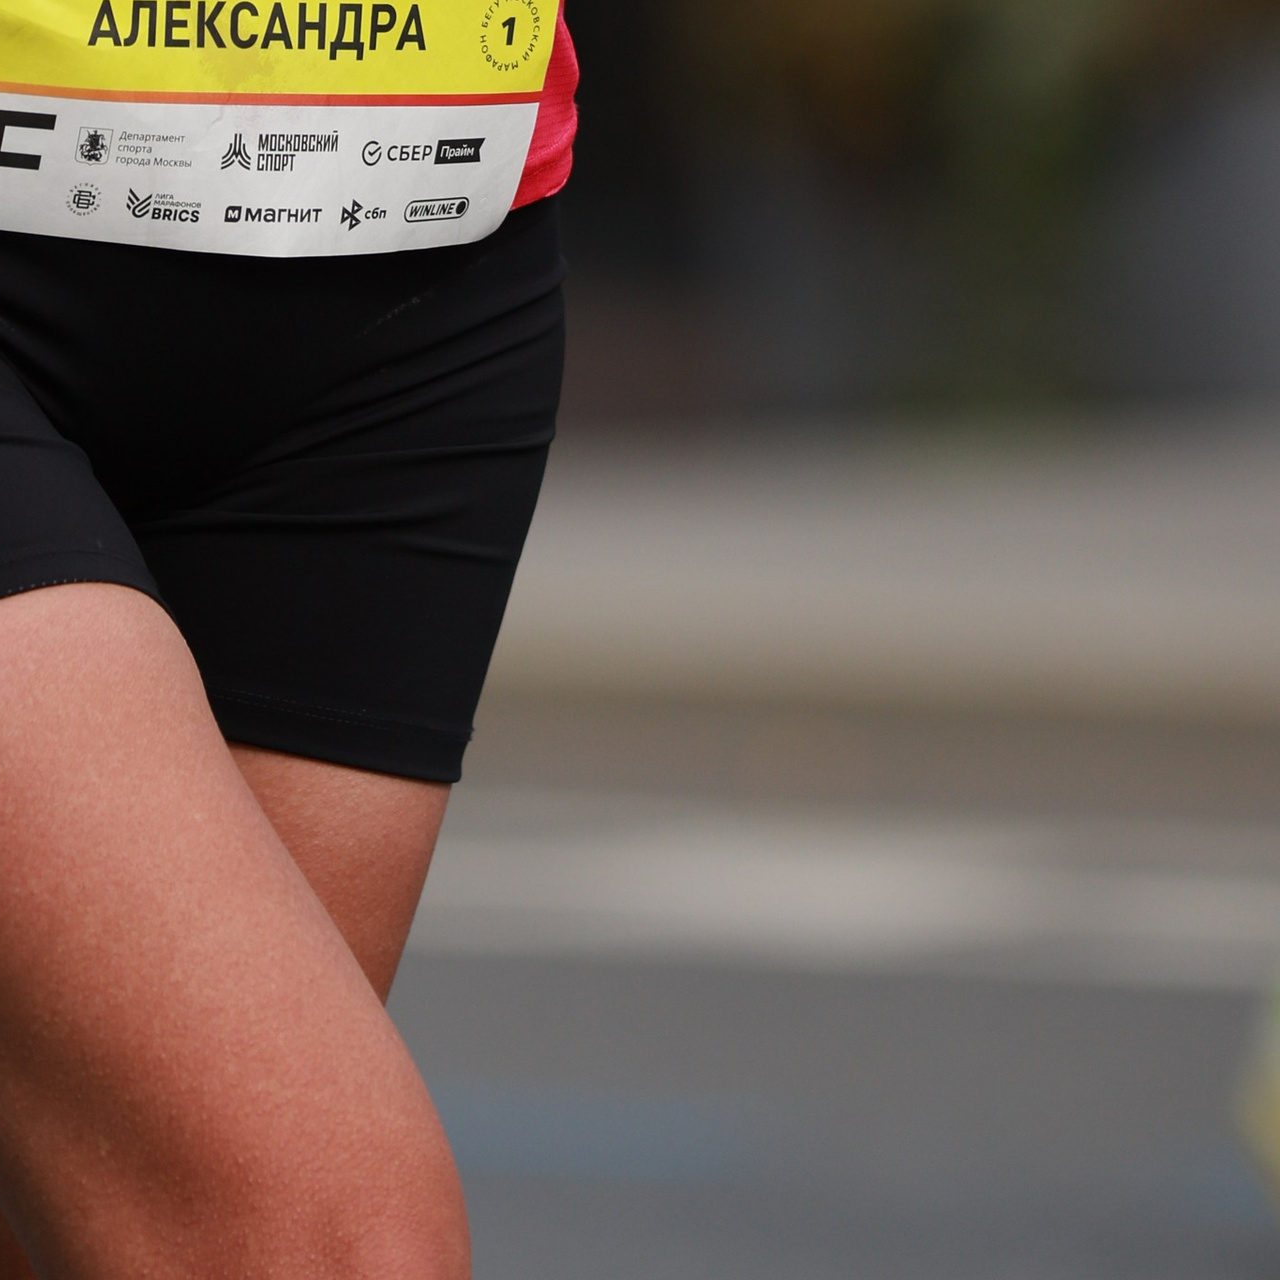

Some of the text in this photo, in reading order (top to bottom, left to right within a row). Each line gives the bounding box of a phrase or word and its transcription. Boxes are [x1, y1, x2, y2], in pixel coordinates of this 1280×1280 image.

[481, 0, 500, 28] БЕГУ
[501, 16, 516, 46] 1
[480, 34, 519, 72] МАРАФОН
[119, 131, 185, 144] Департамент
[257, 130, 339, 153] МОСКОВСКИЙ
[117, 144, 153, 156] спорта
[387, 144, 475, 162] СБЕР Прайм
[115, 156, 192, 168] города Москвы
[257, 153, 297, 172] СПОРТ
[153, 200, 202, 209] МАРАФОНОВ
[155, 193, 175, 201] ЛИГА
[151, 207, 201, 223] BRICS
[364, 207, 387, 220] сбп
[409, 202, 456, 218] WINLINE
